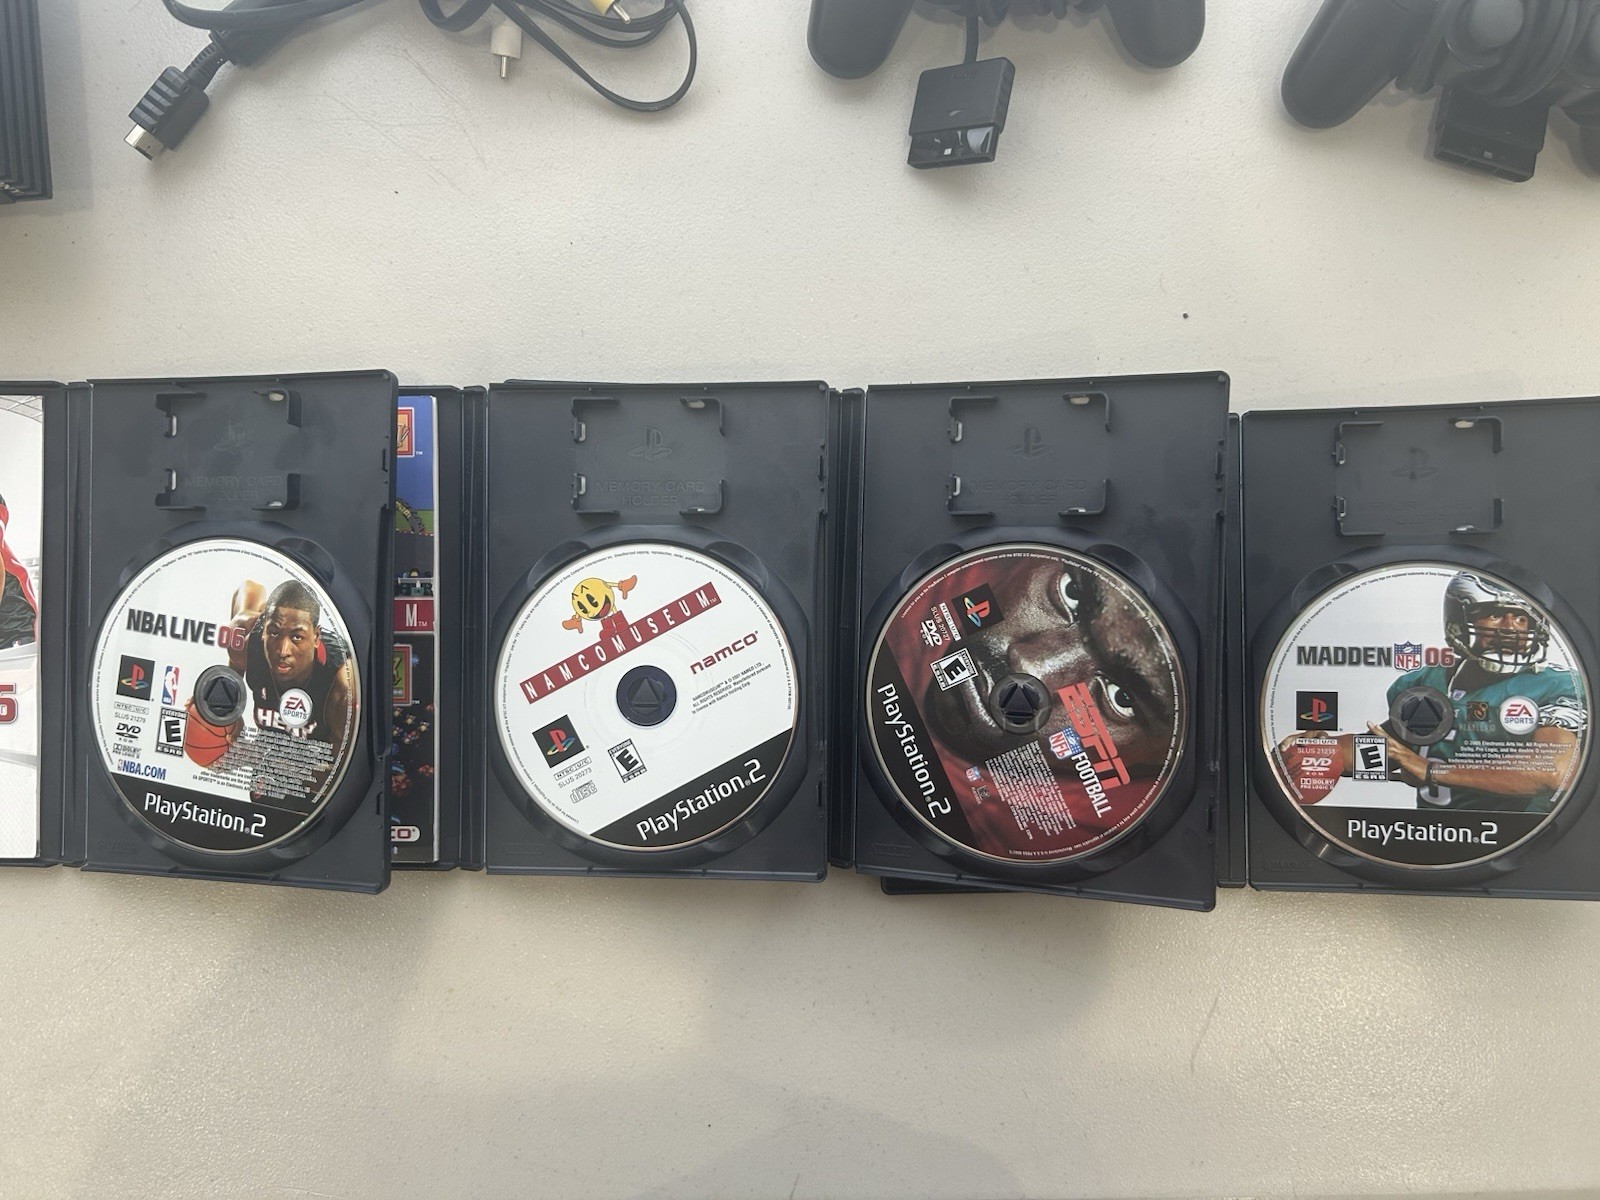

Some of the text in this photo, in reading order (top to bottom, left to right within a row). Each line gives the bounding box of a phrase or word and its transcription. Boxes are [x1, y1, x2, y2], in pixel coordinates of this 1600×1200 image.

[596, 479, 705, 492] MEMORY CARD
[622, 494, 679, 506] HOLDER
[126, 608, 246, 650] NBA LIVE 06
[926, 620, 942, 646] DVD
[690, 632, 758, 674] namco
[1296, 645, 1455, 670] MADDEN NFL 06
[944, 658, 966, 680] E
[283, 710, 308, 719] SPORTS
[284, 696, 306, 712] EA
[1505, 703, 1533, 717] EA
[116, 722, 141, 734] DVD
[164, 719, 181, 742] E
[1050, 731, 1071, 758] NFL
[616, 748, 639, 772] E
[1301, 757, 1332, 767] DVD
[1360, 745, 1383, 770] E
[122, 760, 167, 780] NBA.COM
[558, 776, 575, 788] SLUS
[1071, 751, 1112, 818] FOOTBALL
